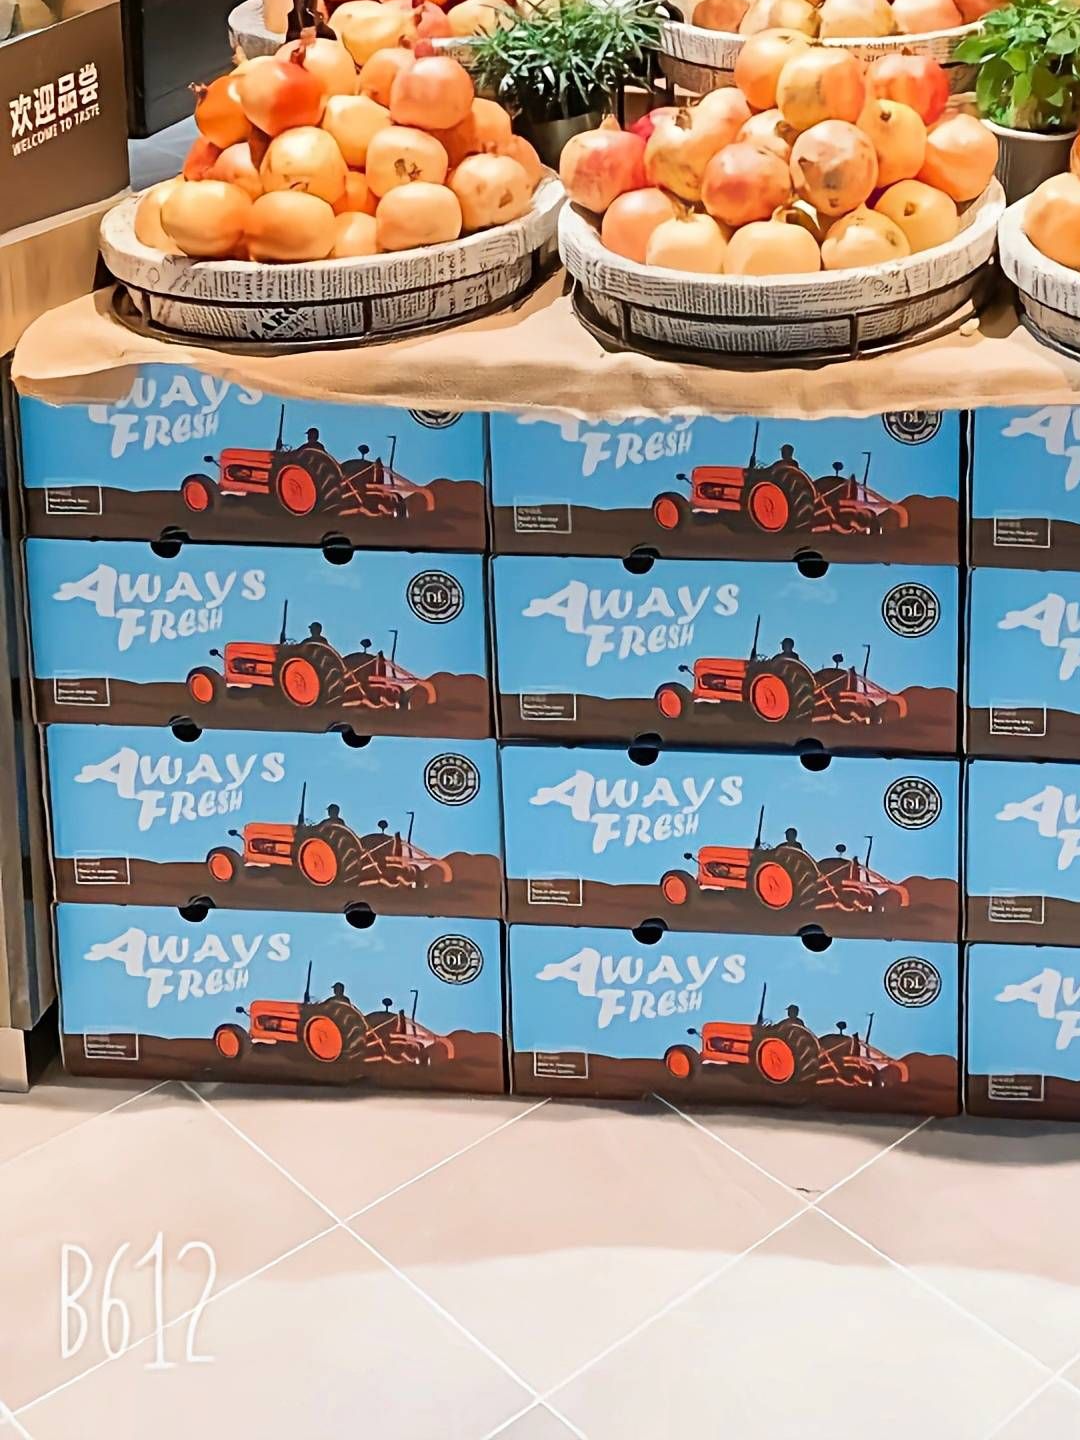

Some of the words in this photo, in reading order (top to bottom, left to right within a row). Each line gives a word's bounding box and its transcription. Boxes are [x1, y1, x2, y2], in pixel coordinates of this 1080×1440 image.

[8, 62, 100, 139] 欢迎品尝
[11, 123, 58, 157] WELCOME
[59, 116, 74, 133] TO
[73, 103, 101, 126] TASTE
[109, 406, 220, 458] FRESH
[580, 429, 694, 477] FRESH
[117, 605, 223, 652] FRESH
[585, 621, 695, 667] FRESH
[137, 789, 244, 832] FRESH
[592, 811, 701, 854] FRESH
[147, 967, 250, 1009] FRESH
[597, 989, 703, 1029] FRESH
